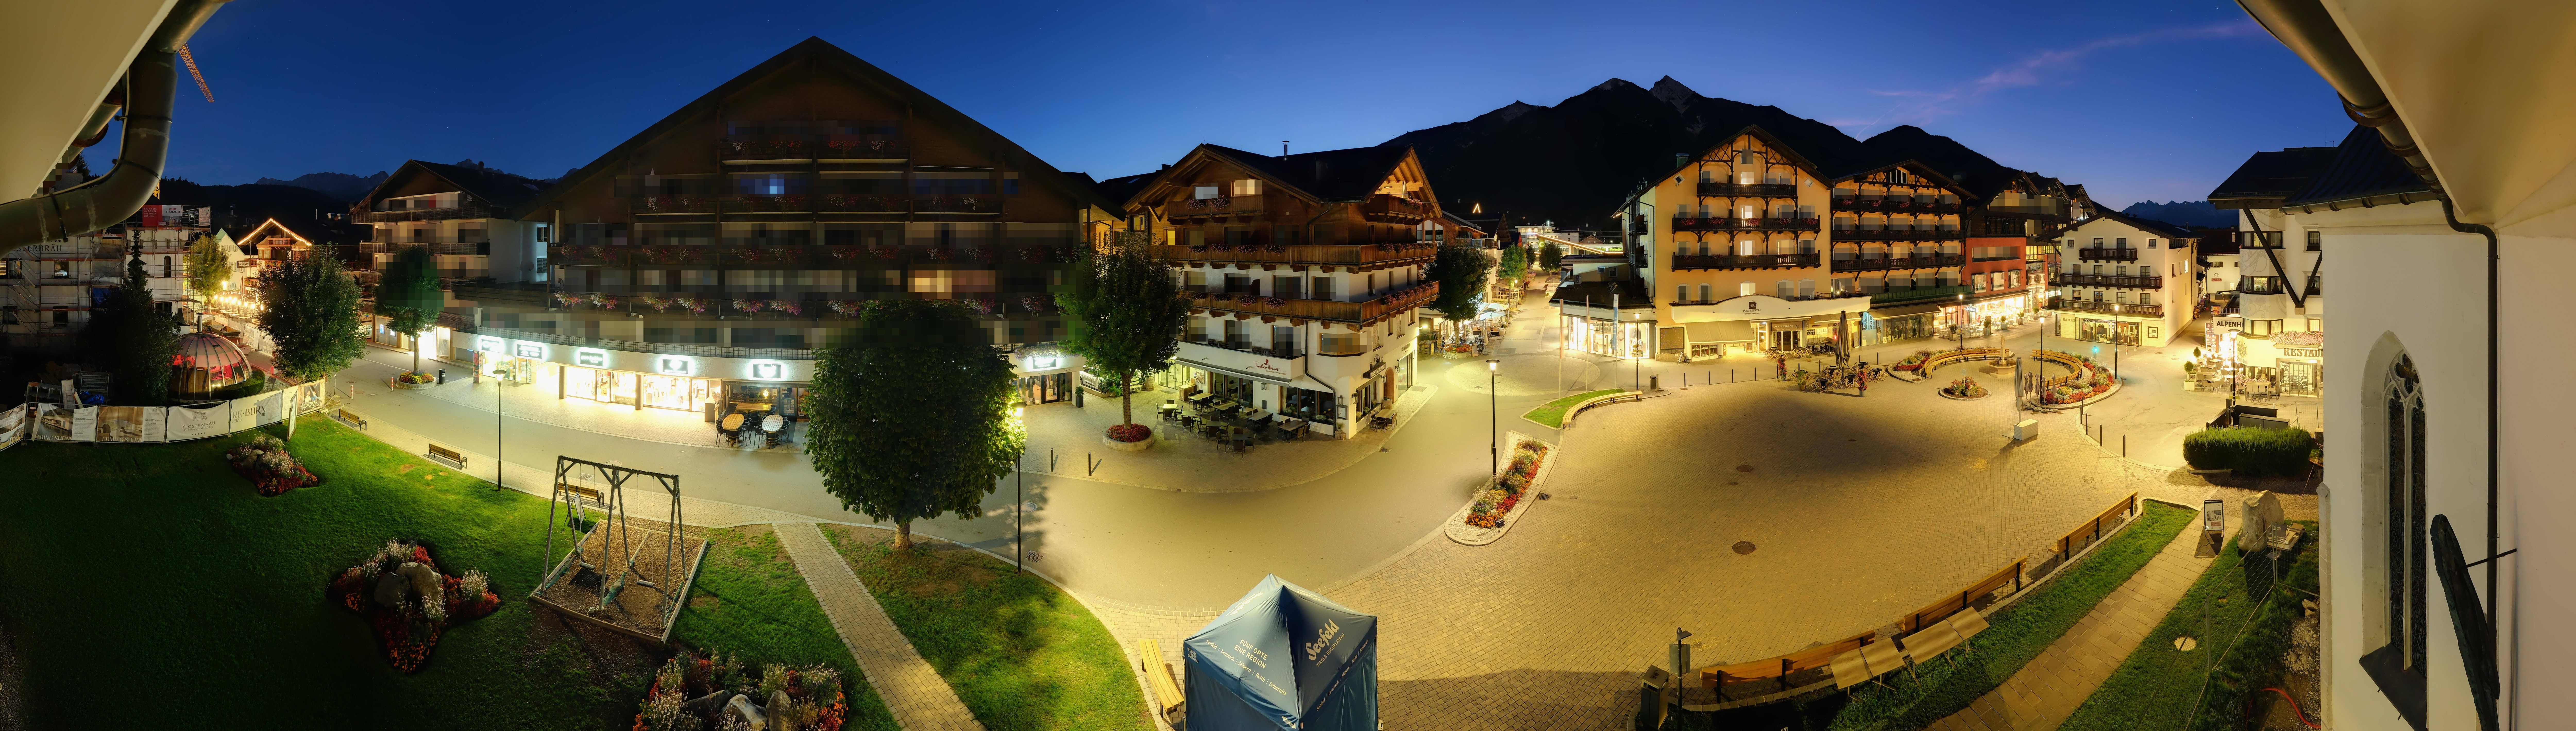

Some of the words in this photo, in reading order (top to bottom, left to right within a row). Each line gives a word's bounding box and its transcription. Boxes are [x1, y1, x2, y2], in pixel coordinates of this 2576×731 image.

[1401, 343, 1410, 351] SAILER
[1371, 364, 1385, 377] RESTAURANT
[1240, 639, 1253, 650] FÜNF
[1253, 648, 1268, 660] ORTE
[1306, 618, 1339, 660] Seefeld
[1316, 654, 1327, 667] TIROLS
[1326, 633, 1345, 655] HOCHPLATEAU
[1188, 654, 1199, 664] plateau
[1206, 640, 1218, 649] Seefeld
[1221, 649, 1235, 661] Leutasch
[1238, 661, 1251, 673] Mösern
[1255, 673, 1265, 682] Reith
[1269, 682, 1287, 696] Scharnitz
[1234, 645, 1246, 655] EINE
[1246, 652, 1266, 669] REGION
[1317, 697, 1325, 711] Seefeld
[1328, 680, 1339, 696] Leutasch
[1342, 665, 1350, 678] Mösern
[1360, 639, 1369, 653] Scharnitz
